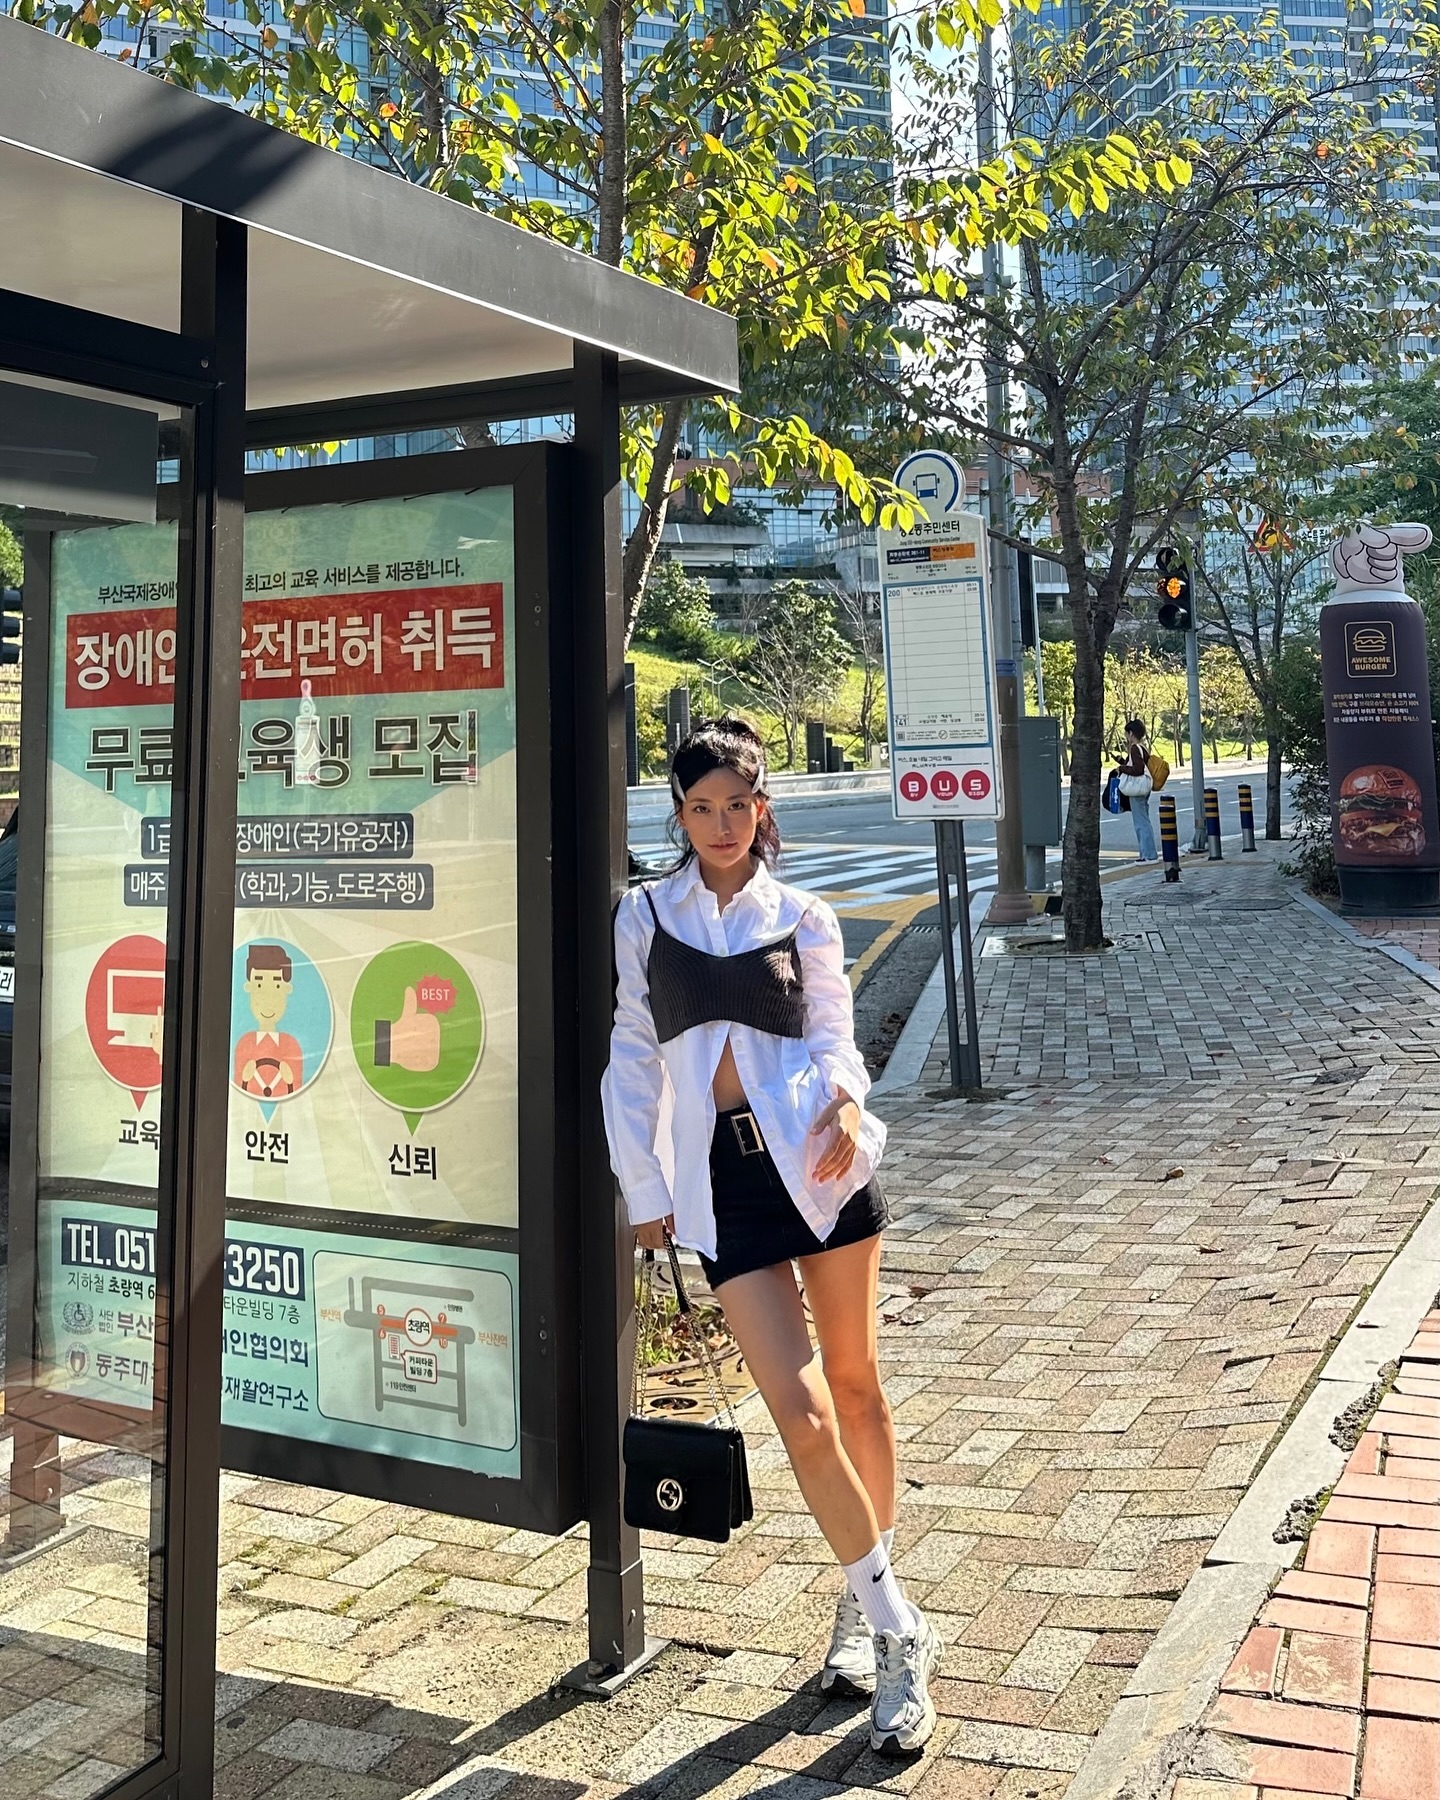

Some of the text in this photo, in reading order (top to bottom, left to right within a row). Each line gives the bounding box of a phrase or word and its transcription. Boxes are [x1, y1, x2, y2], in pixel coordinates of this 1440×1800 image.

[244, 572, 286, 592] 최고의
[290, 569, 318, 589] 교육
[323, 564, 381, 587] 서비스를
[385, 557, 465, 582] 제공합니다.
[400, 605, 498, 672] 취득
[1351, 656, 1391, 664] AWESOME
[238, 713, 352, 790] 육생
[367, 709, 480, 788] 모집
[130, 873, 168, 903] 매주
[421, 986, 450, 1002] BEST
[118, 1118, 160, 1151] 교육
[244, 1130, 290, 1165] 안전
[388, 1143, 438, 1181] 신뢰
[67, 1271, 104, 1294] 지하철
[108, 1276, 144, 1301] 초량역
[278, 1304, 301, 1325] 7층
[98, 1309, 114, 1321] 사단
[320, 1308, 342, 1323] 부산역
[98, 1321, 114, 1335] 법인
[407, 1318, 430, 1335] 초량역
[478, 1331, 508, 1348] 부산진역
[408, 1355, 434, 1368] 커피타운
[409, 1366, 434, 1378] 빌딩 7층
